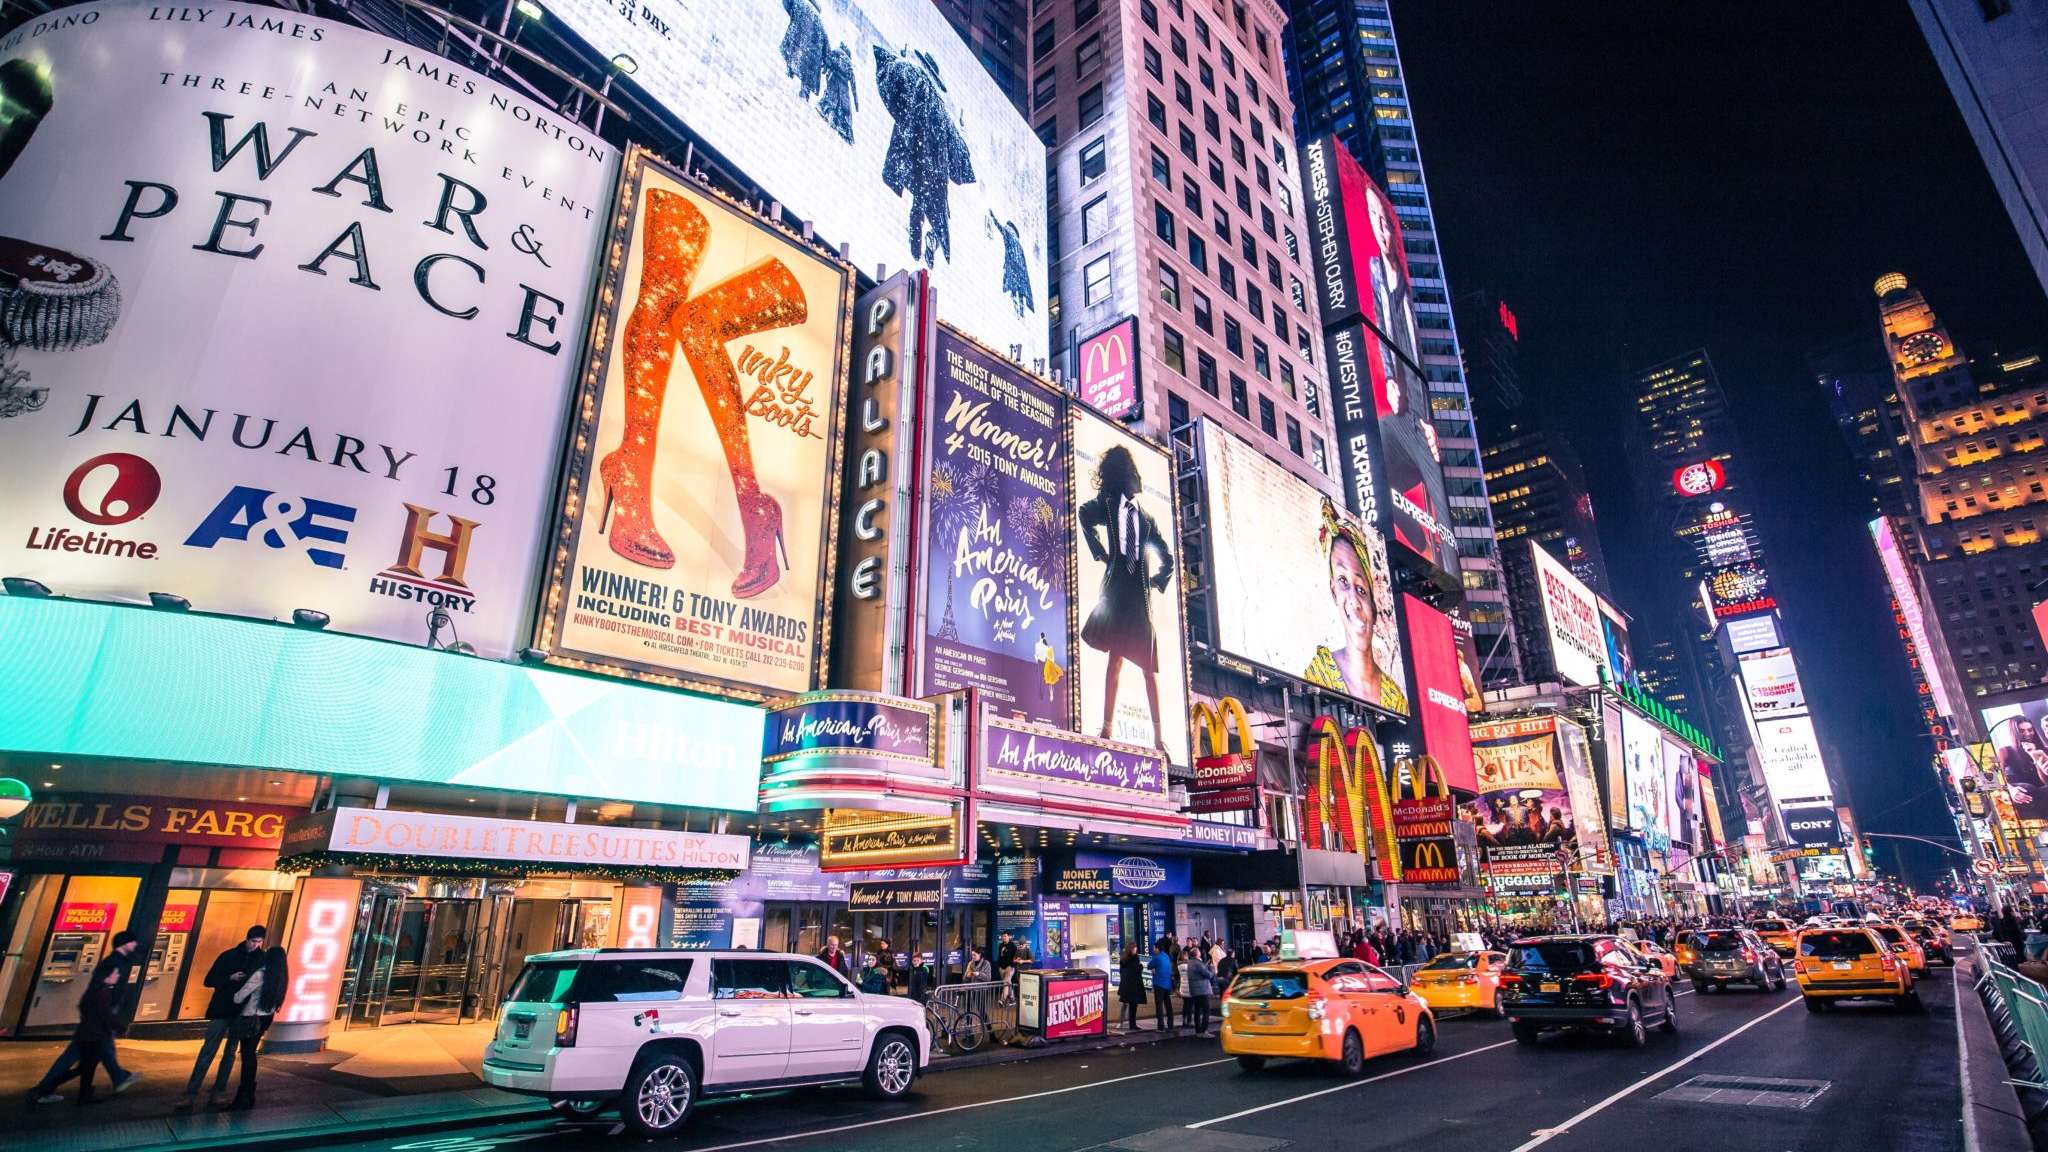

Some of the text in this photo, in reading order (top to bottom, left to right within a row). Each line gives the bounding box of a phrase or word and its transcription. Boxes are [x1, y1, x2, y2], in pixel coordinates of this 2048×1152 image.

[0, 11, 100, 51] UL DANO
[148, 6, 326, 43] LILY JAMES
[618, 1, 637, 27] 31.
[641, 4, 672, 41] DAY.
[322, 80, 472, 142] AN EPIC
[381, 48, 608, 165] JAMES NORTON
[201, 110, 552, 269] WAR &
[501, 167, 595, 221] EVENT
[99, 179, 565, 357] PEACE
[946, 349, 1055, 418] THE MOST AWARD-WINNING
[950, 365, 1053, 429] MUSICAL OF THE SEASON!
[1088, 371, 1125, 395] OPEN
[743, 385, 824, 440] Boots
[944, 390, 1056, 472] Winner!
[1335, 330, 1378, 526] #GIVESTYLE EXPRESS
[69, 393, 498, 507] JANUARY 18
[852, 296, 896, 600] PALACE
[945, 432, 1056, 496] 4 2015 TONY AWARDS
[183, 484, 359, 571] A&E
[1702, 516, 1741, 530] TOSHIBA
[1704, 528, 1743, 543] TOSHIBA
[25, 526, 158, 560] Lifetime
[953, 525, 1054, 610] American
[369, 576, 477, 615] HISTORY
[581, 565, 808, 645] WINNER! 6 TONY AWARDS
[970, 576, 1035, 630] Paris
[1714, 597, 1776, 617] TOSHIBA
[573, 612, 695, 649] KINKYBOOTSTHEMUSICAL.COM
[699, 639, 715, 652] FOR
[715, 643, 745, 659] TICKETS
[744, 650, 762, 663] CALL
[575, 594, 807, 659] INCLUDING BEST MUSICAL
[1891, 598, 1929, 694] ERNST &
[1754, 700, 1778, 709] HOT
[613, 721, 738, 770] Hilton
[781, 718, 796, 745] An
[795, 711, 864, 744] American
[867, 714, 901, 747] Paris
[1493, 723, 1517, 738] FAT
[997, 733, 1020, 765] An
[1023, 734, 1092, 782] American
[1095, 751, 1130, 788] Paris
[1475, 742, 1541, 757] OMETHING
[1195, 762, 1253, 779] cDonald's
[1197, 775, 1242, 786] Restaurant
[1223, 794, 1250, 805] HOURS
[1393, 802, 1450, 816] McDonald's
[23, 803, 153, 832] WELLS
[160, 807, 287, 840] FARG
[1195, 826, 1256, 845] MONEY ATM
[1790, 820, 1833, 830] SONY
[70, 844, 105, 857] ATM
[681, 850, 740, 866] HILTON
[683, 838, 706, 851] BY
[1055, 880, 1110, 890] EXCHANGE
[1063, 869, 1098, 880] MONEY
[1133, 868, 1166, 880] EXCHANGE
[1487, 875, 1552, 887] LUGGAGE
[66, 908, 105, 916] WELLS
[851, 887, 885, 905] Winner!
[885, 890, 894, 905] 4
[896, 892, 913, 904] TONY
[913, 890, 940, 903] AWARDS
[64, 916, 103, 924] FARGO
[1046, 995, 1081, 1027] JERSEY
[1082, 989, 1104, 1017] BOYS
